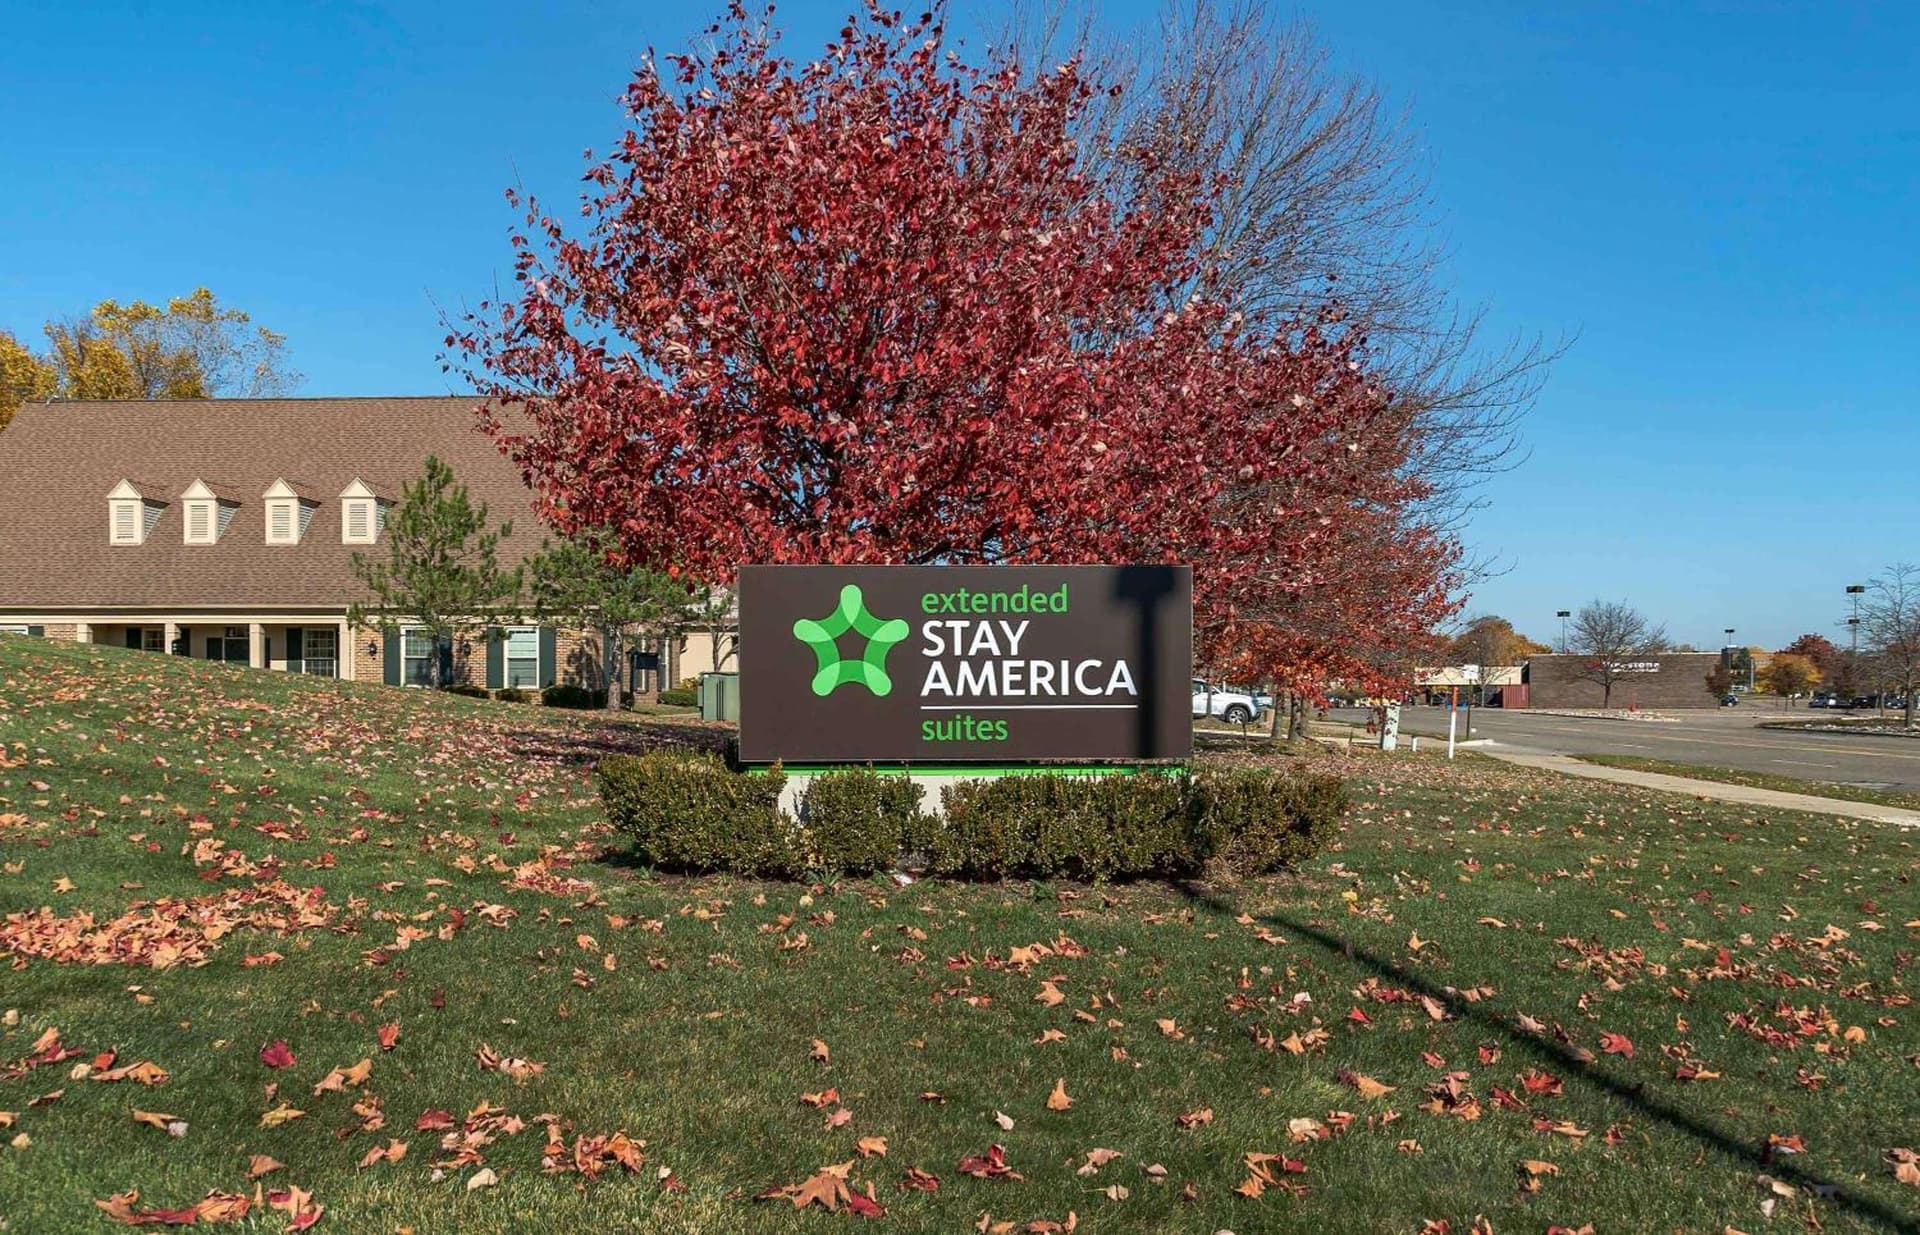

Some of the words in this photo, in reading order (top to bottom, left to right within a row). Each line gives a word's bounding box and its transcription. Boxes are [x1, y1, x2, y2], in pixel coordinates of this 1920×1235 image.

[921, 584, 1069, 613] extended
[921, 620, 1030, 656] STAY
[920, 659, 1138, 696] AMERICA
[921, 715, 1008, 741] suites
